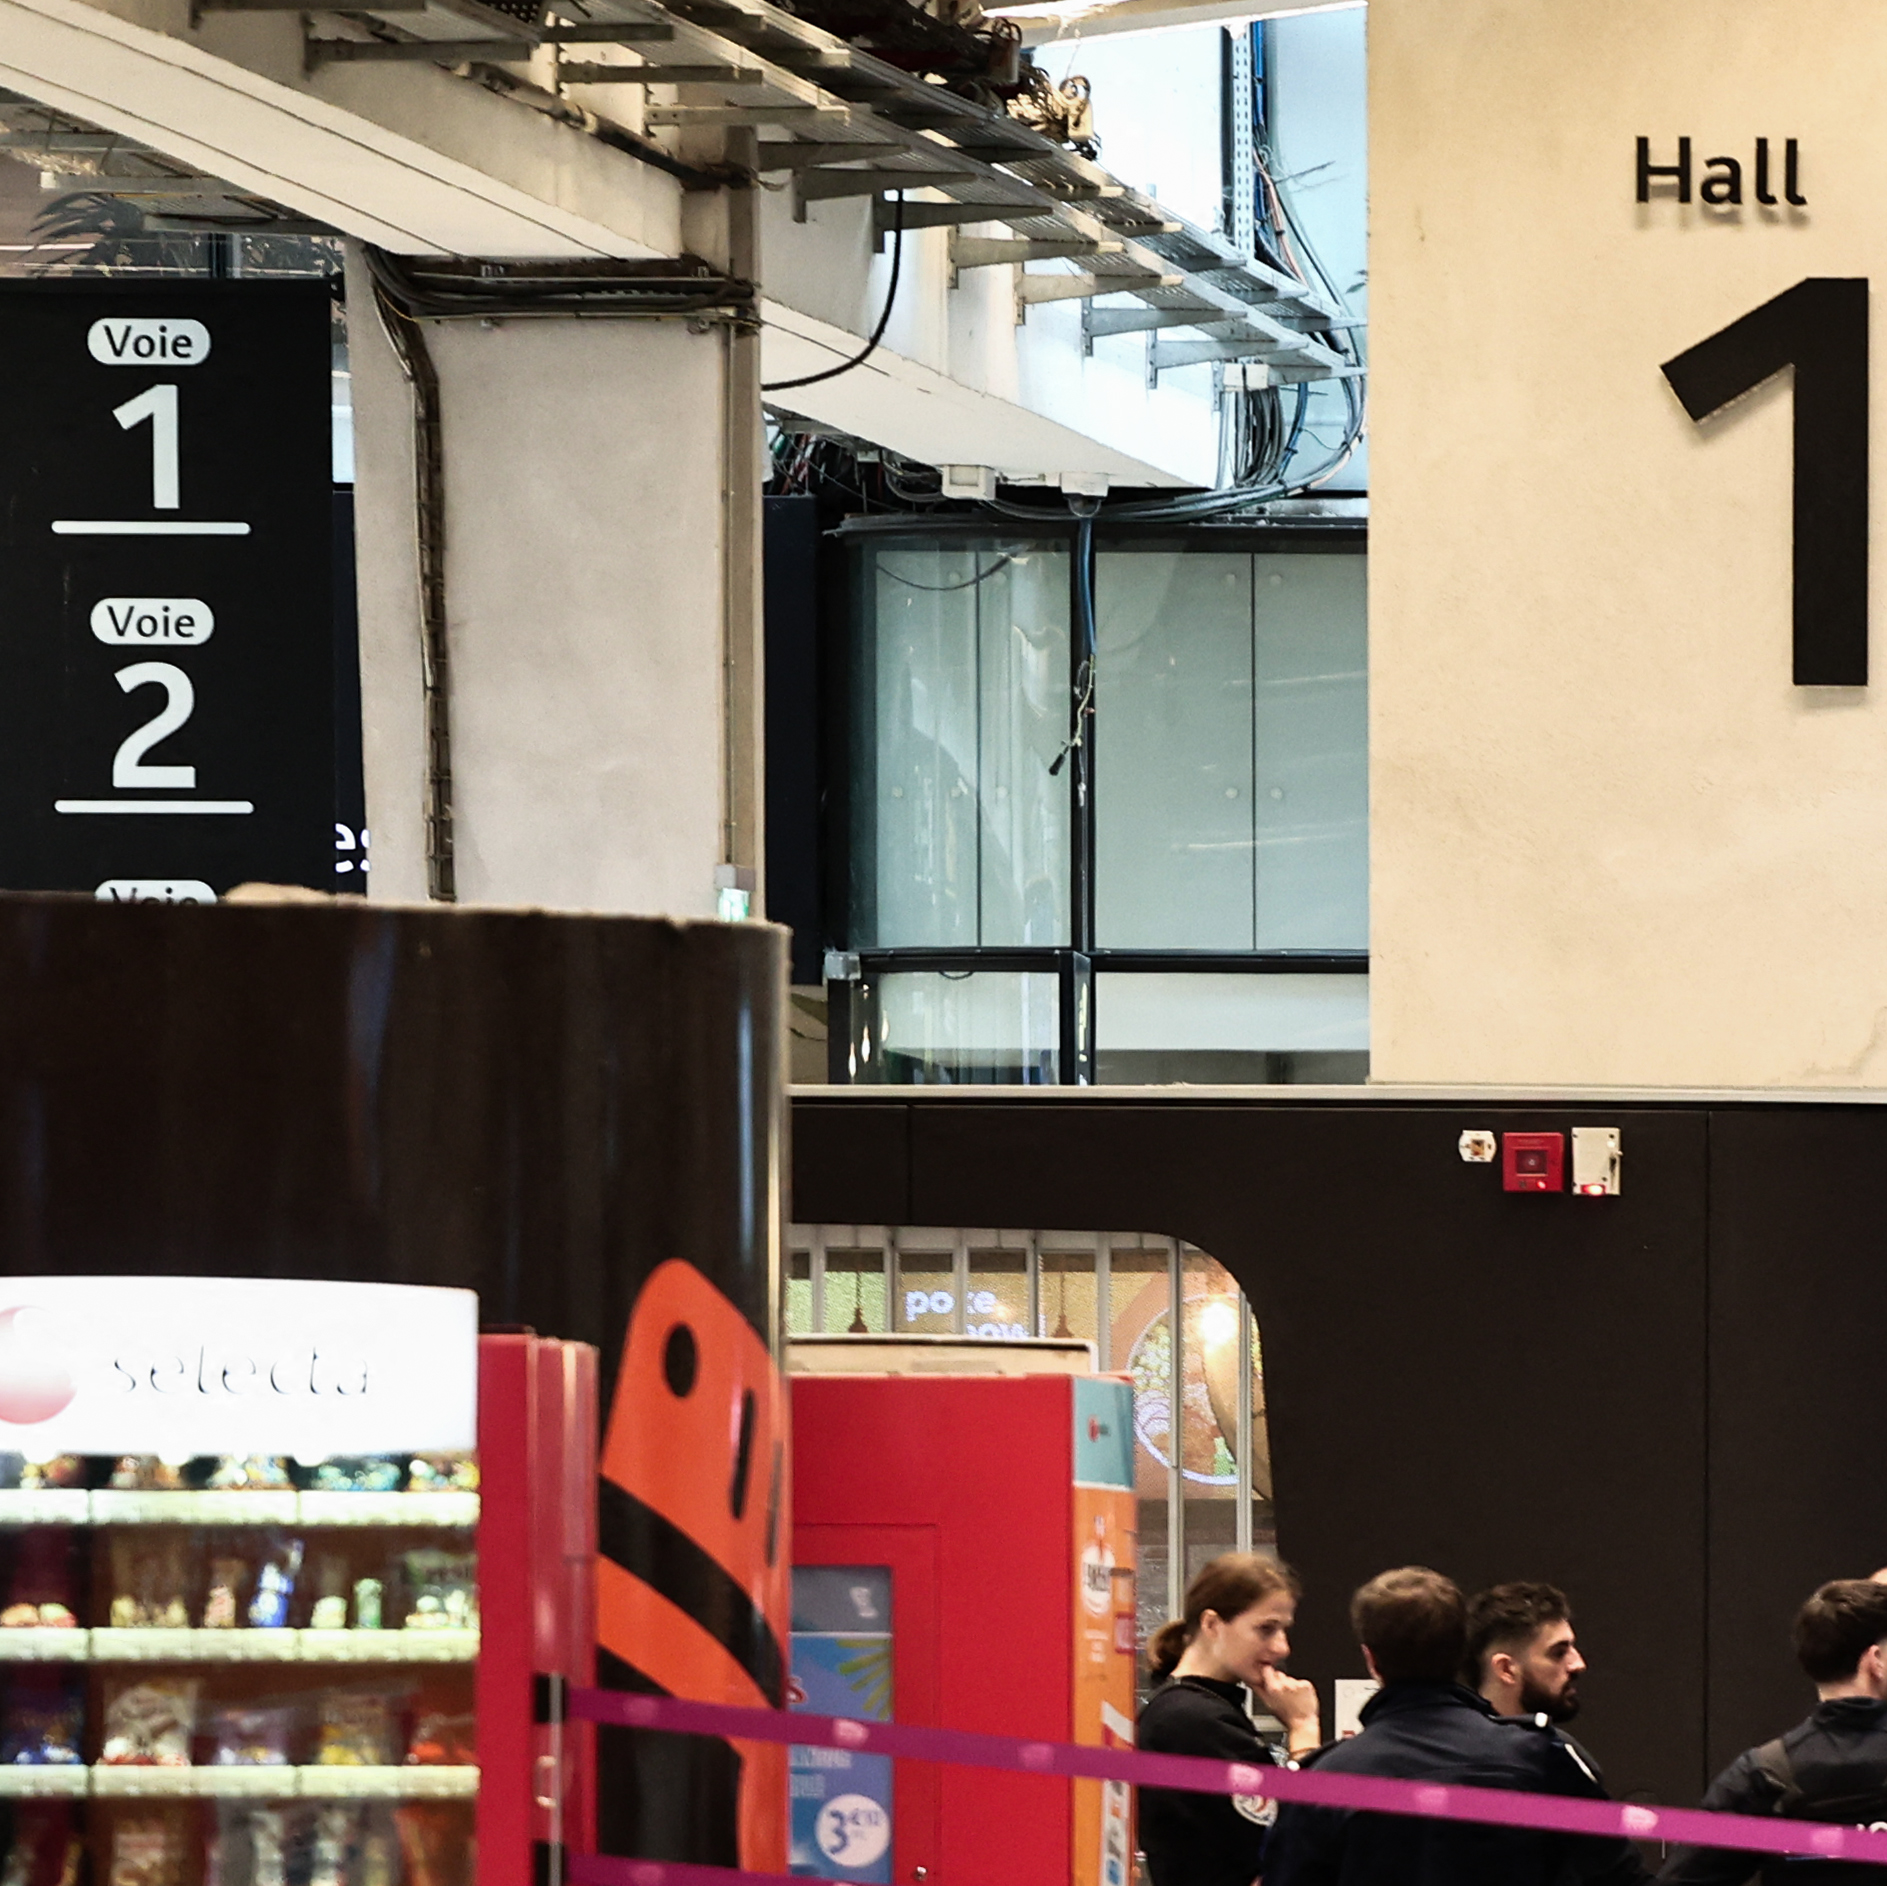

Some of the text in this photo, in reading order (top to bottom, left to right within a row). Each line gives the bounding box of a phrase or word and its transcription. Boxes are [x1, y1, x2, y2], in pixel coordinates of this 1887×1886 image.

[1635, 136, 1809, 207] Hall
[102, 324, 193, 361] Voie
[112, 383, 181, 510] 1
[1660, 277, 1869, 687] 1
[106, 604, 197, 640] Voie
[112, 662, 197, 789] 2
[904, 1288, 997, 1322] poe
[113, 1344, 369, 1395] selecta
